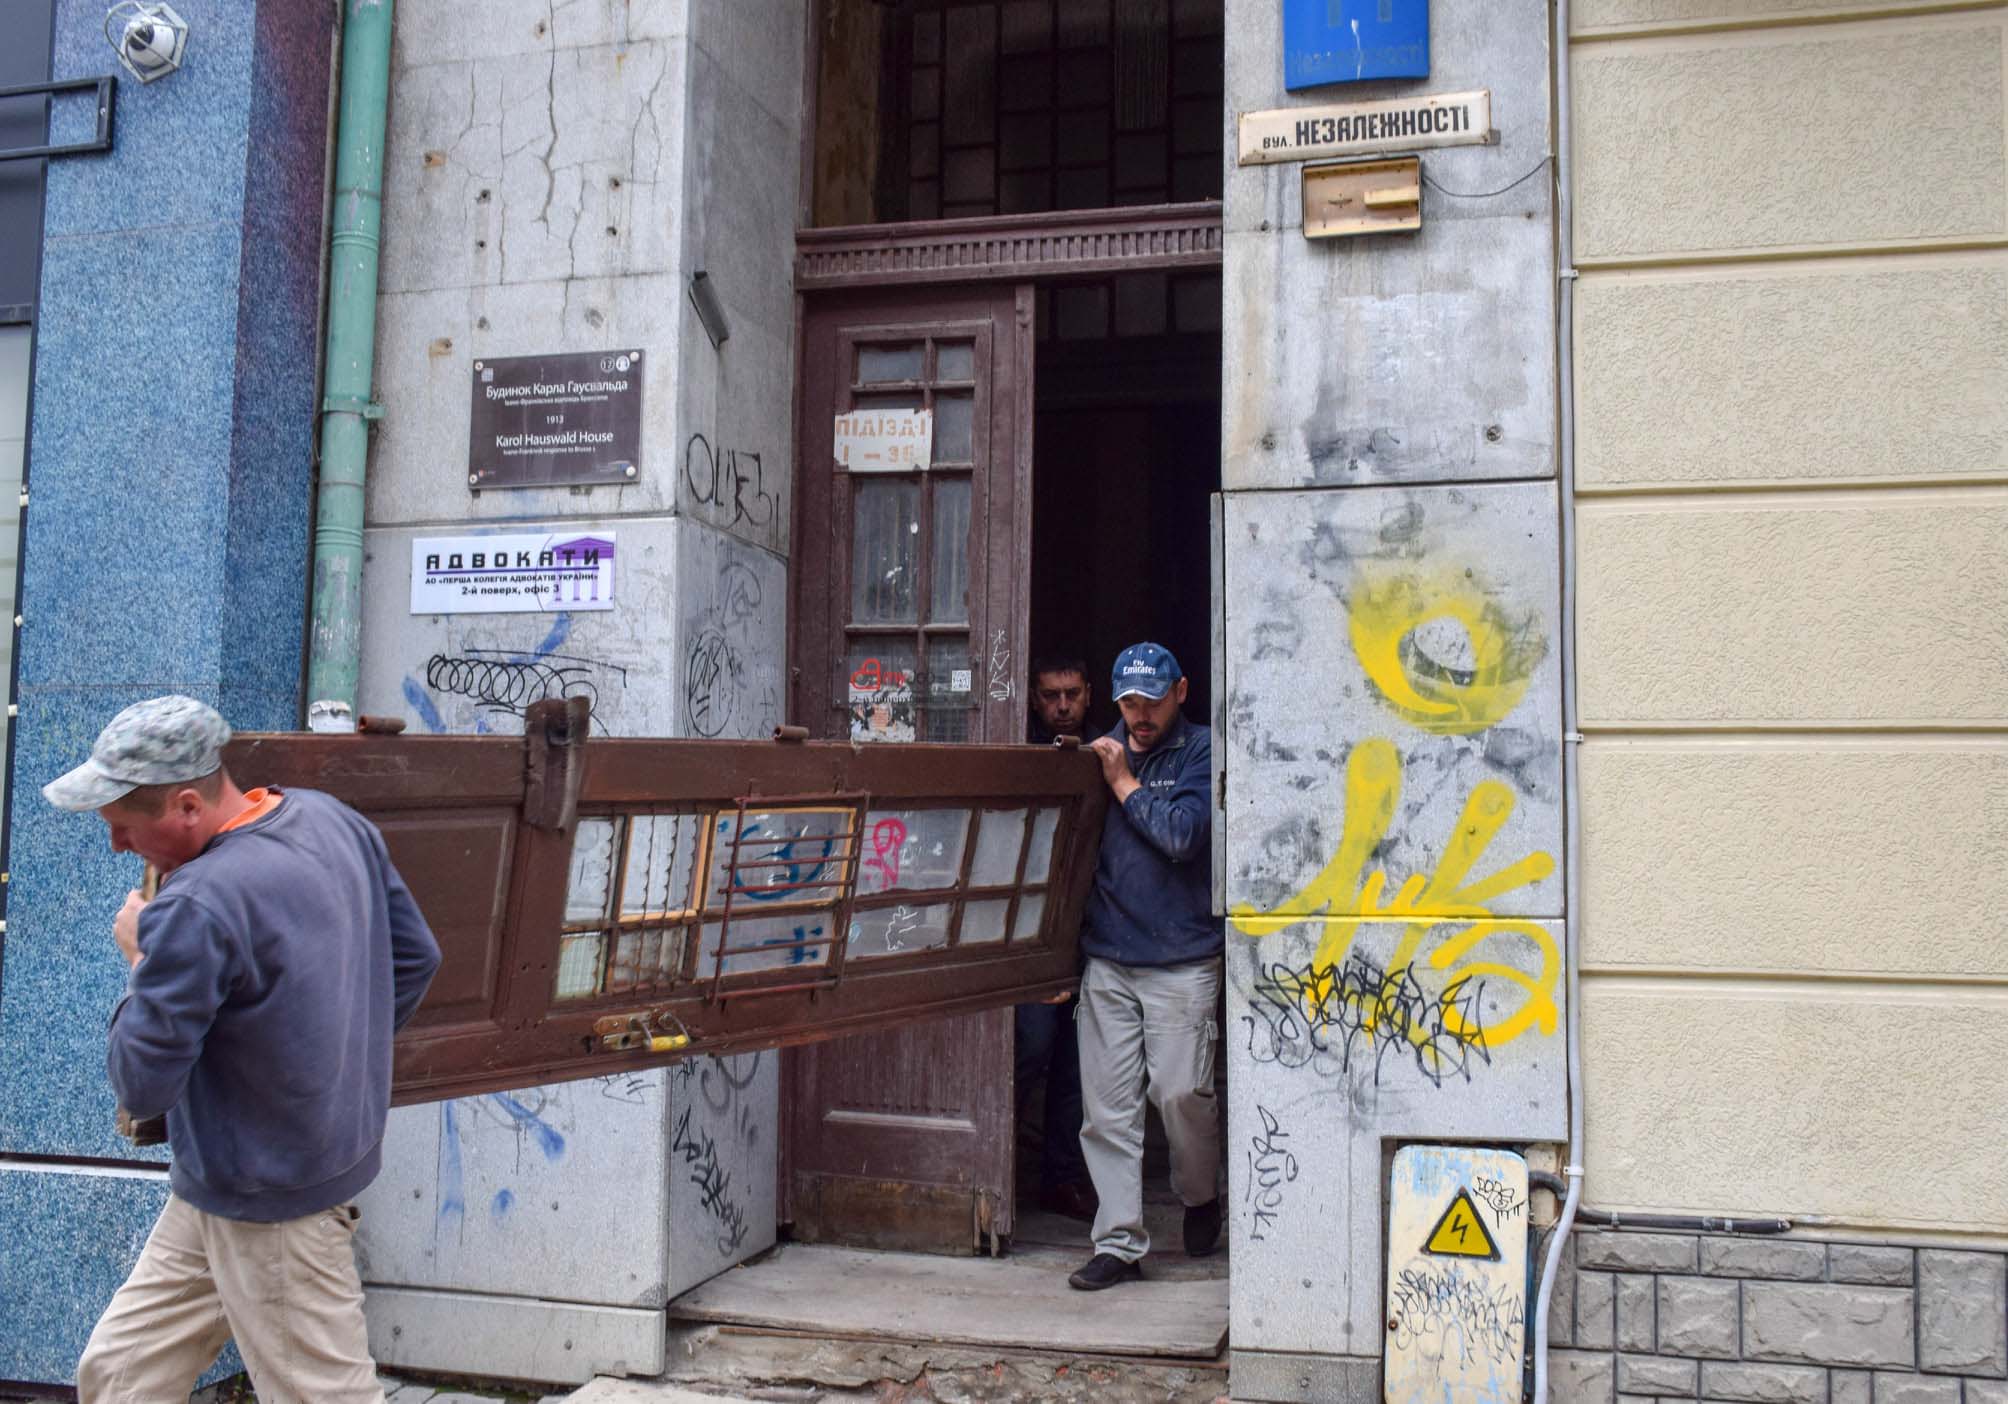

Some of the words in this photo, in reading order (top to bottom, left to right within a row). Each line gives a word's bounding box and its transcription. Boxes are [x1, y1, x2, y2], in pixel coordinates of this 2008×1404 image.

[1296, 105, 1469, 147] НЕЗАЛЕЖНОСТІ
[486, 384, 531, 400] Будинок
[533, 382, 565, 397] Карла
[496, 434, 522, 447] Karol
[525, 431, 576, 446] Hauswald
[580, 431, 614, 442] House
[426, 550, 600, 569] АДВОКАТИ
[553, 584, 560, 593] 3
